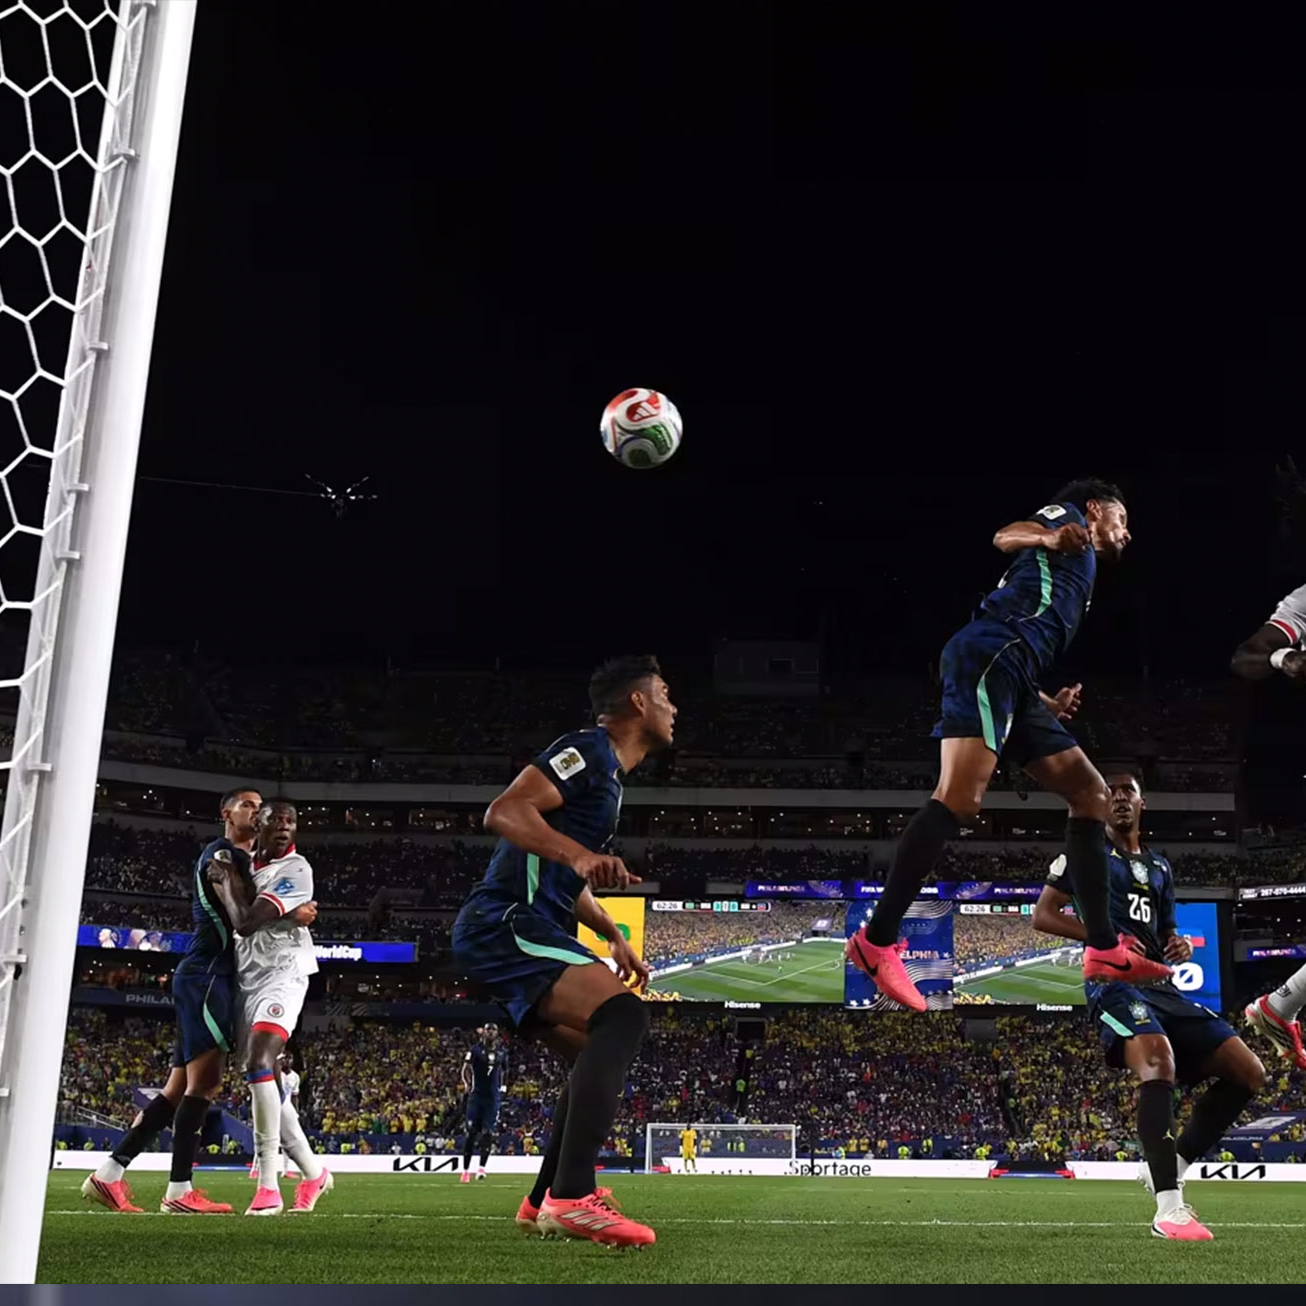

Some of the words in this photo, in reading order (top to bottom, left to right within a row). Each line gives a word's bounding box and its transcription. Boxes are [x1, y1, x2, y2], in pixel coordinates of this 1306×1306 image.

[1127, 893, 1151, 923] 26
[313, 944, 362, 961] WorldCup
[126, 994, 175, 1005] PHILA
[724, 1001, 761, 1009] Hisense
[1036, 1003, 1073, 1012] Hisense
[486, 1065, 494, 1077] 7
[393, 1157, 459, 1172] KIA
[789, 1160, 872, 1176] Sportage
[1200, 1164, 1266, 1180] KIA
